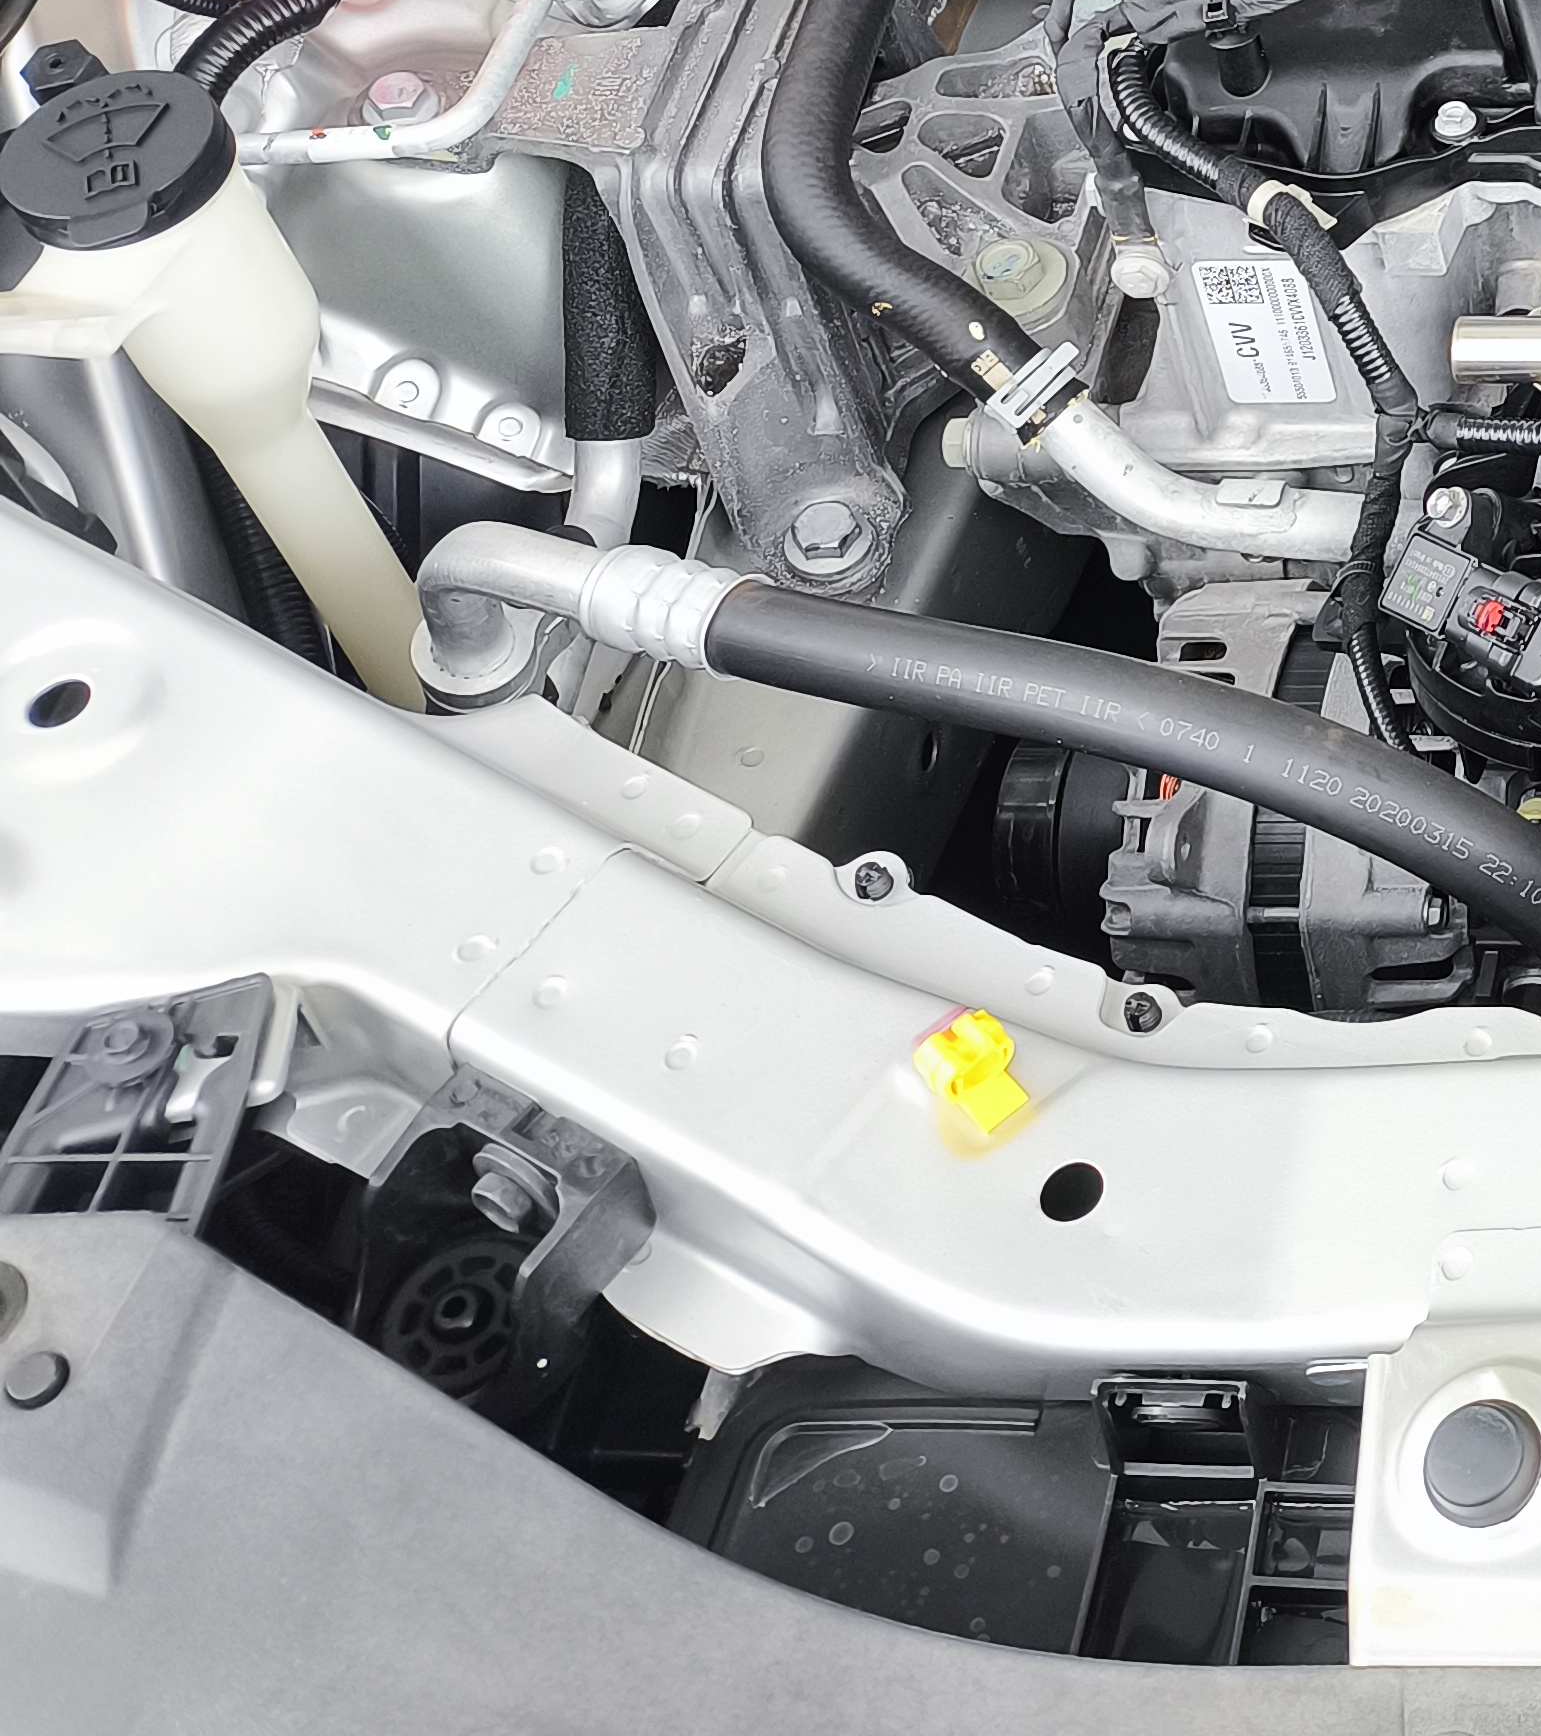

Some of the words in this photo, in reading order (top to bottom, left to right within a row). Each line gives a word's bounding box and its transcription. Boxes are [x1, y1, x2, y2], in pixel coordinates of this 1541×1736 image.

[1228, 322, 1260, 358] CVV
[935, 665, 962, 689] PA
[1022, 681, 1066, 709] PET
[1159, 716, 1220, 751] 0740
[1281, 757, 1343, 796] 1120
[1349, 786, 1474, 861] 20200315
